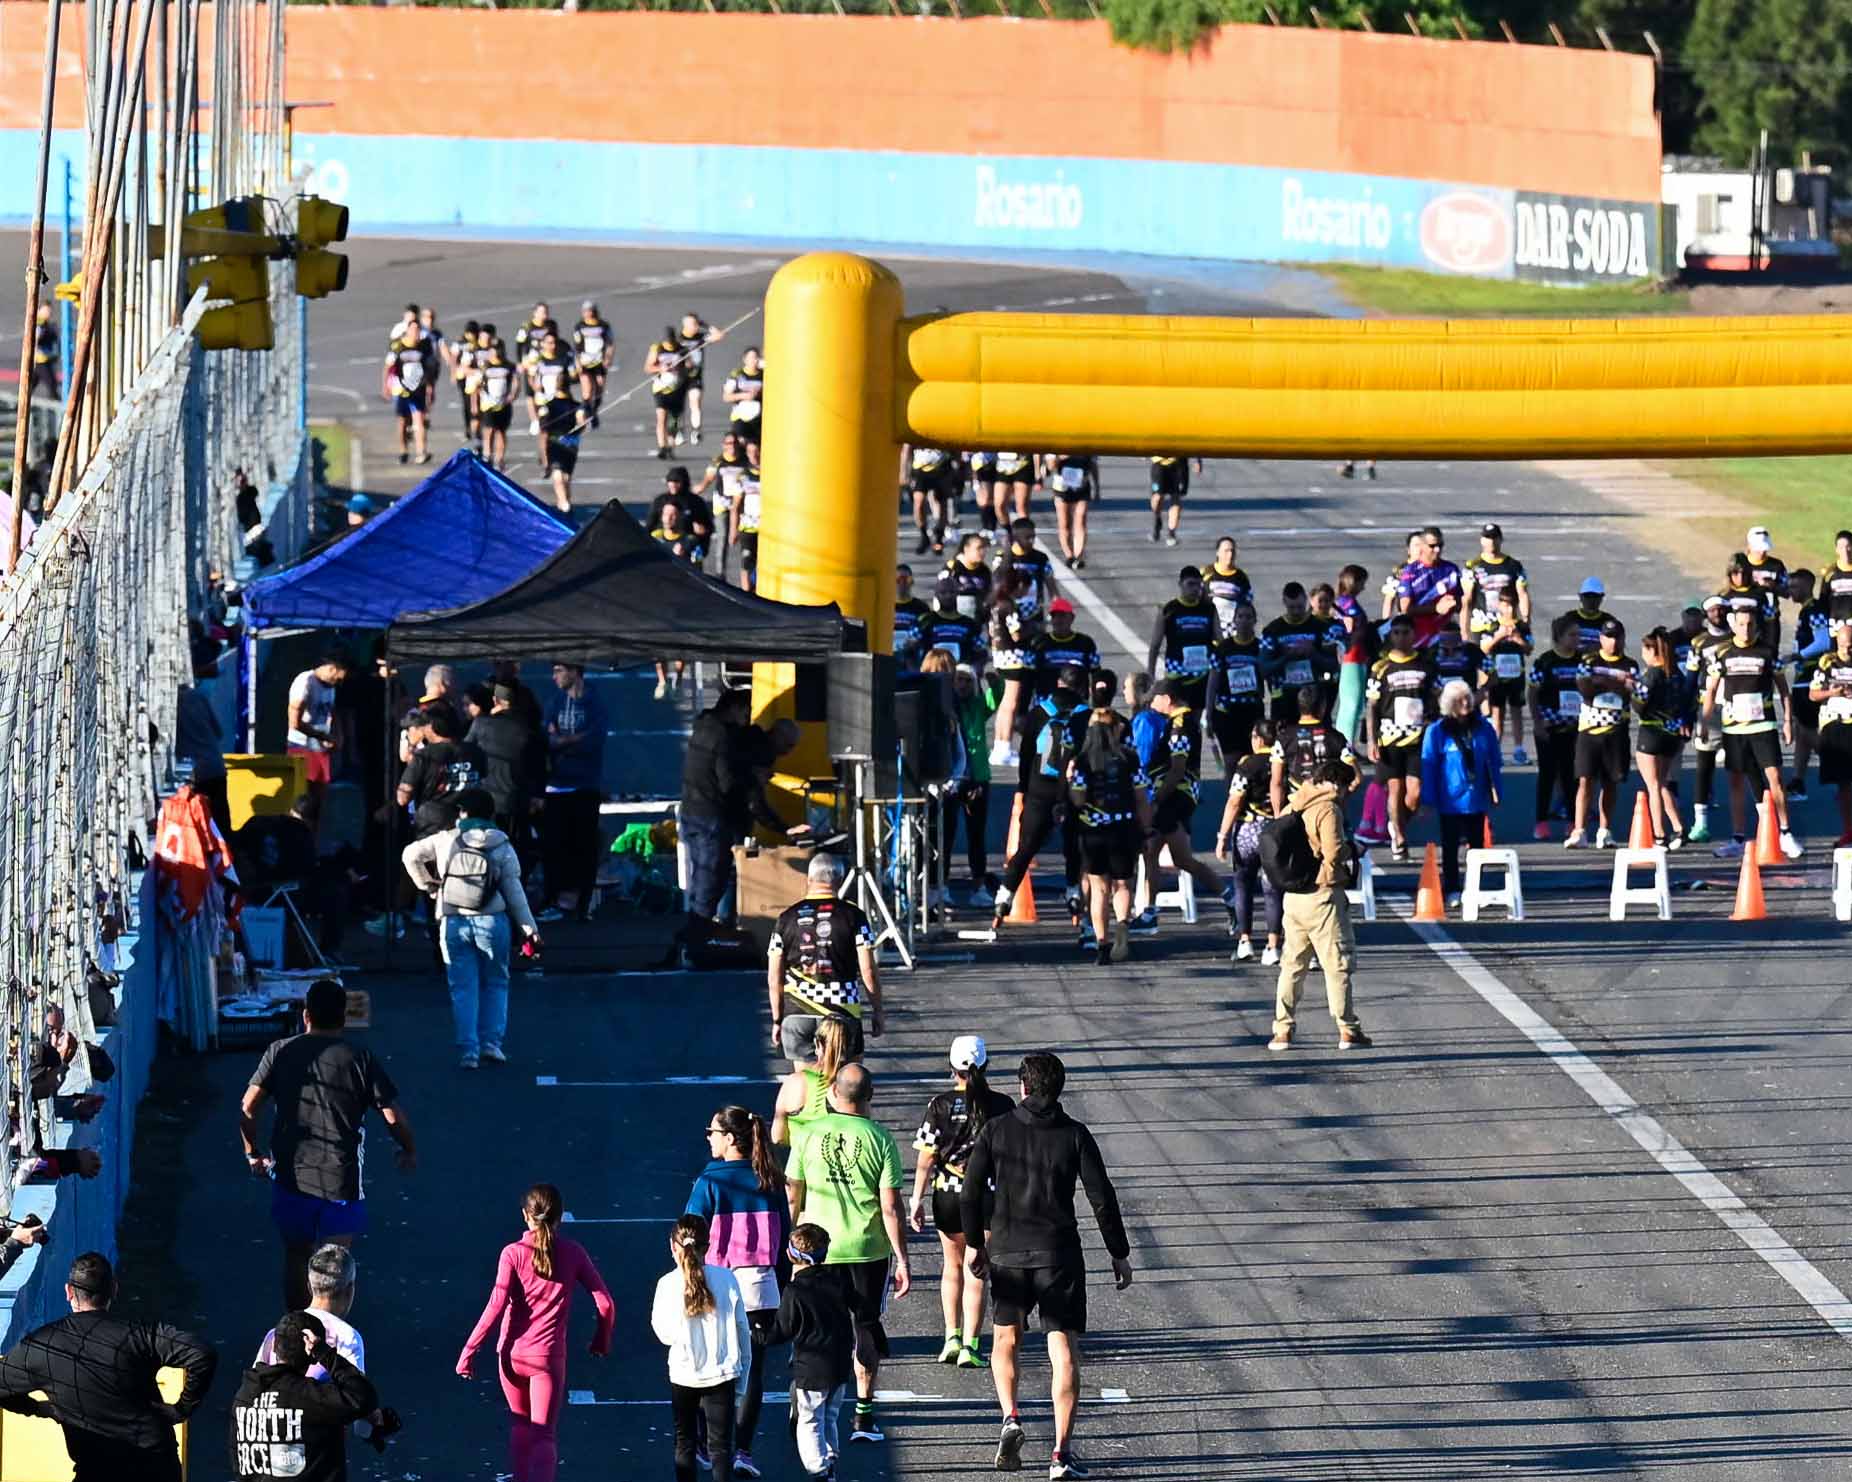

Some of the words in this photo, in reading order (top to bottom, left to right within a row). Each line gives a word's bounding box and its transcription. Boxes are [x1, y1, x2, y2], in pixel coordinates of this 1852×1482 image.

[975, 164, 1083, 229] Rosario
[1282, 177, 1391, 249] Rosario
[236, 1407, 303, 1441] NORTH
